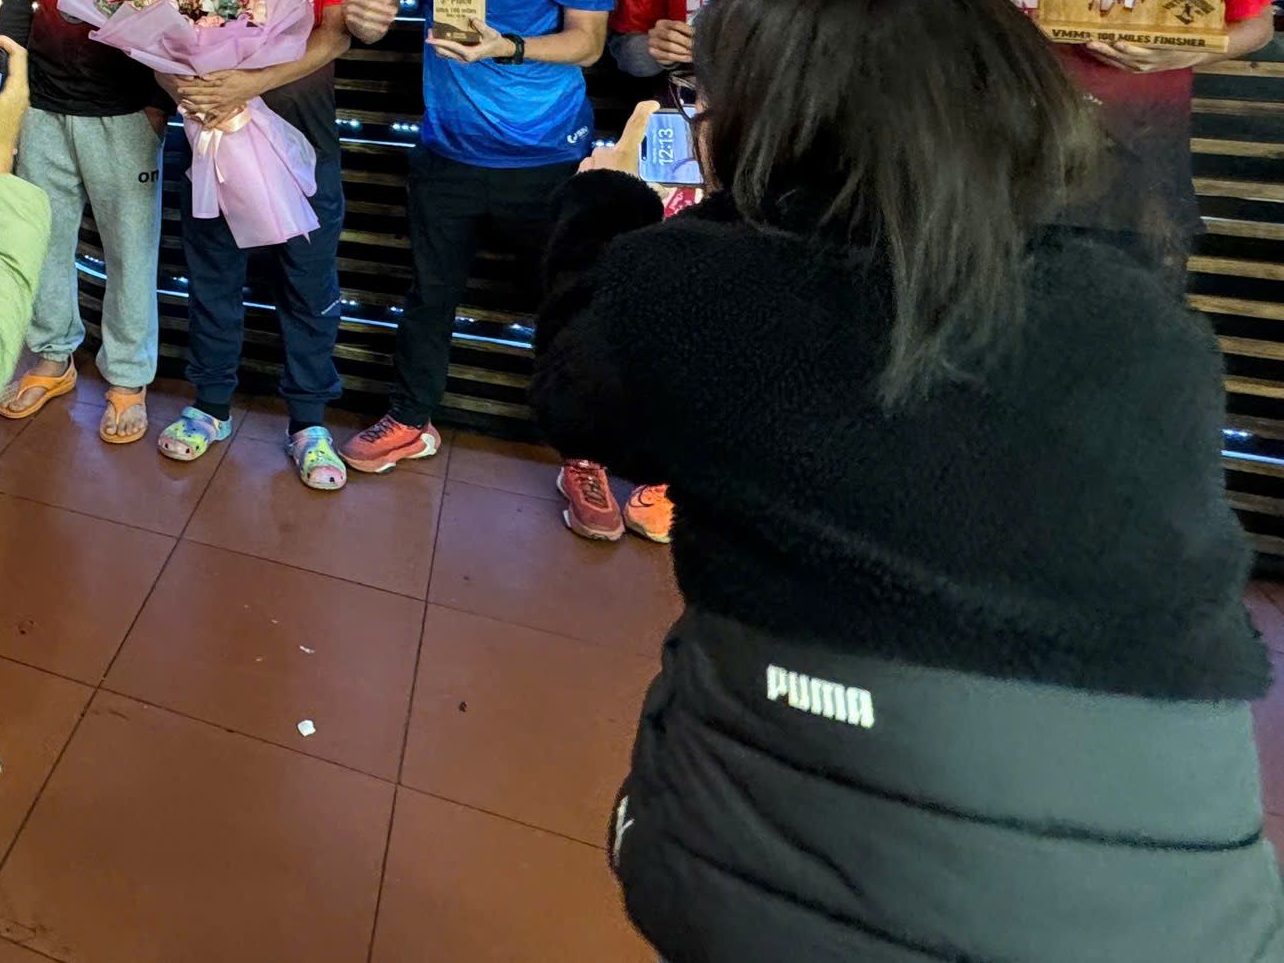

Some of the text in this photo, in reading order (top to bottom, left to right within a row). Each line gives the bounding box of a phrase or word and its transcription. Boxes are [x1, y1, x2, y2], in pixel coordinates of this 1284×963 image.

[1118, 33, 1151, 43] MILES
[1153, 35, 1206, 47] FINISHER
[658, 128, 674, 166] 12:13
[766, 663, 875, 729] PUMA
